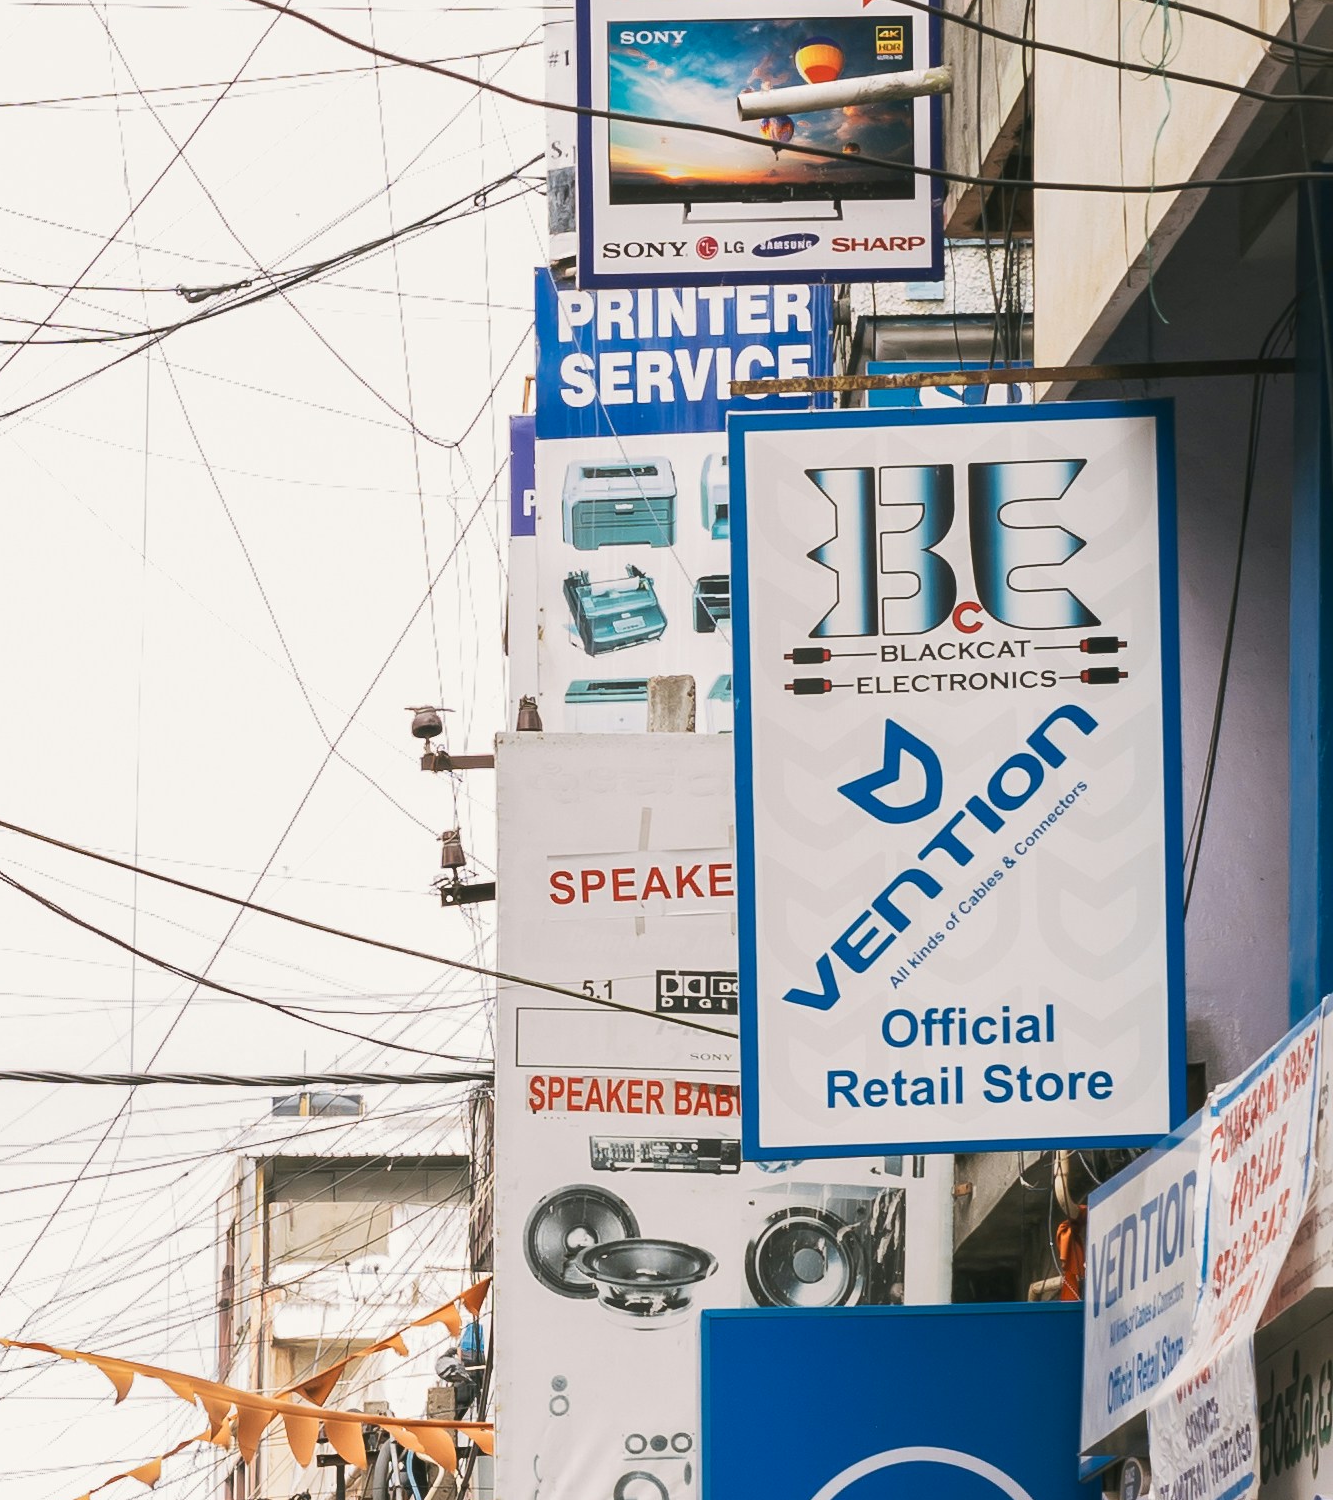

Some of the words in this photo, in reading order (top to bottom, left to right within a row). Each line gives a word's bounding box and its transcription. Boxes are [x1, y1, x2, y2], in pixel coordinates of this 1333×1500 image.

[620, 29, 688, 46] SONY
[602, 241, 687, 259] SONY
[759, 239, 812, 250] SAMSUNG
[831, 236, 925, 252] SHARP
[558, 286, 811, 342] PRINTER
[561, 345, 812, 408] SERVICE
[881, 640, 1031, 663] BLACKCAT
[858, 669, 1057, 695] ELECTRONICS
[782, 704, 1099, 1013] VENTION
[958, 872, 1004, 917] Cables
[1013, 779, 1090, 861] Connectors
[582, 979, 614, 1000] 5.1
[881, 1005, 1055, 1049] Official
[529, 1076, 664, 1114] SPEAKER
[827, 1067, 964, 1110] Retail
[983, 1064, 1114, 1103] Store
[1108, 1358, 1134, 1415] Official
